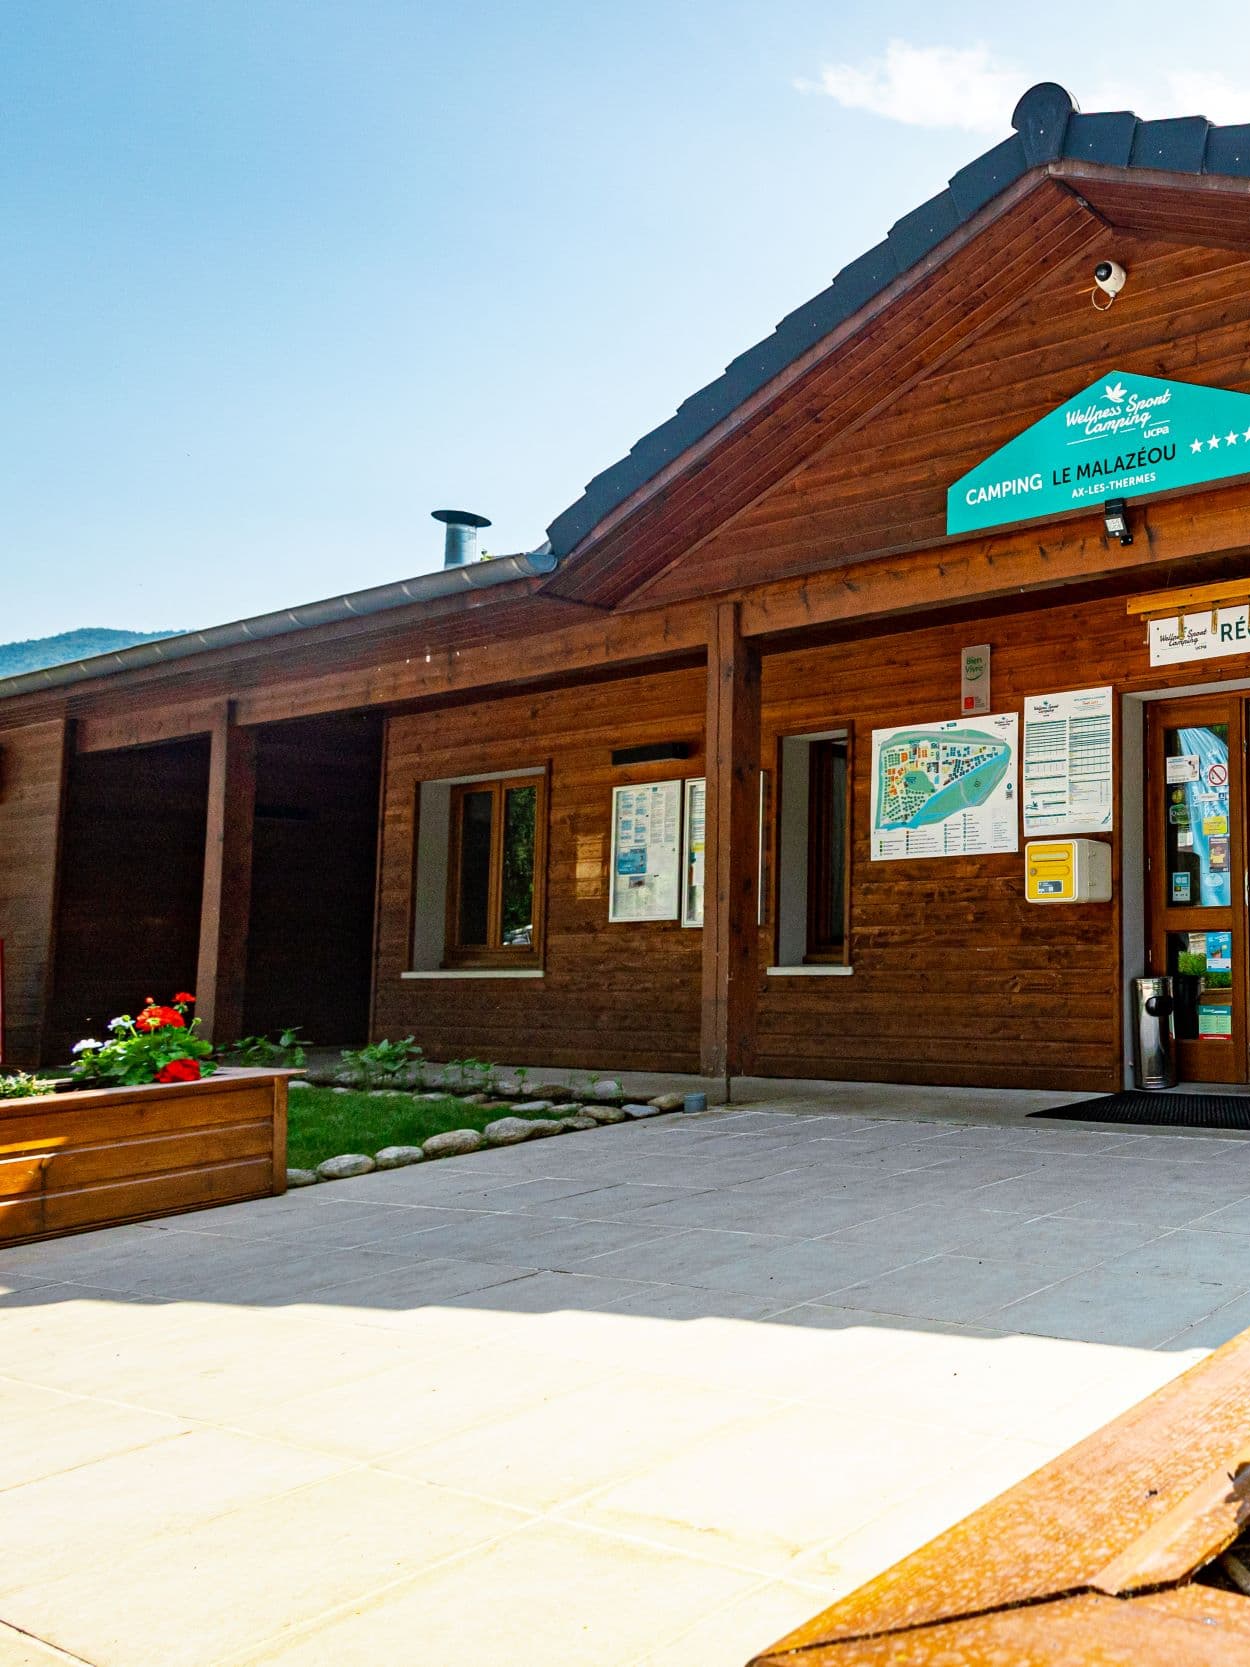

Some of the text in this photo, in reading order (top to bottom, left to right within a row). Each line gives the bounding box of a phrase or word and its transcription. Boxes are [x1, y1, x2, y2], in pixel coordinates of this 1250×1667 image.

[1066, 388, 1172, 427] Wellness Sport
[1085, 412, 1152, 435] Camping
[965, 443, 1176, 506] CAMPING LE MALAZÉOU
[1071, 472, 1156, 499] AX-LES-THERMES
